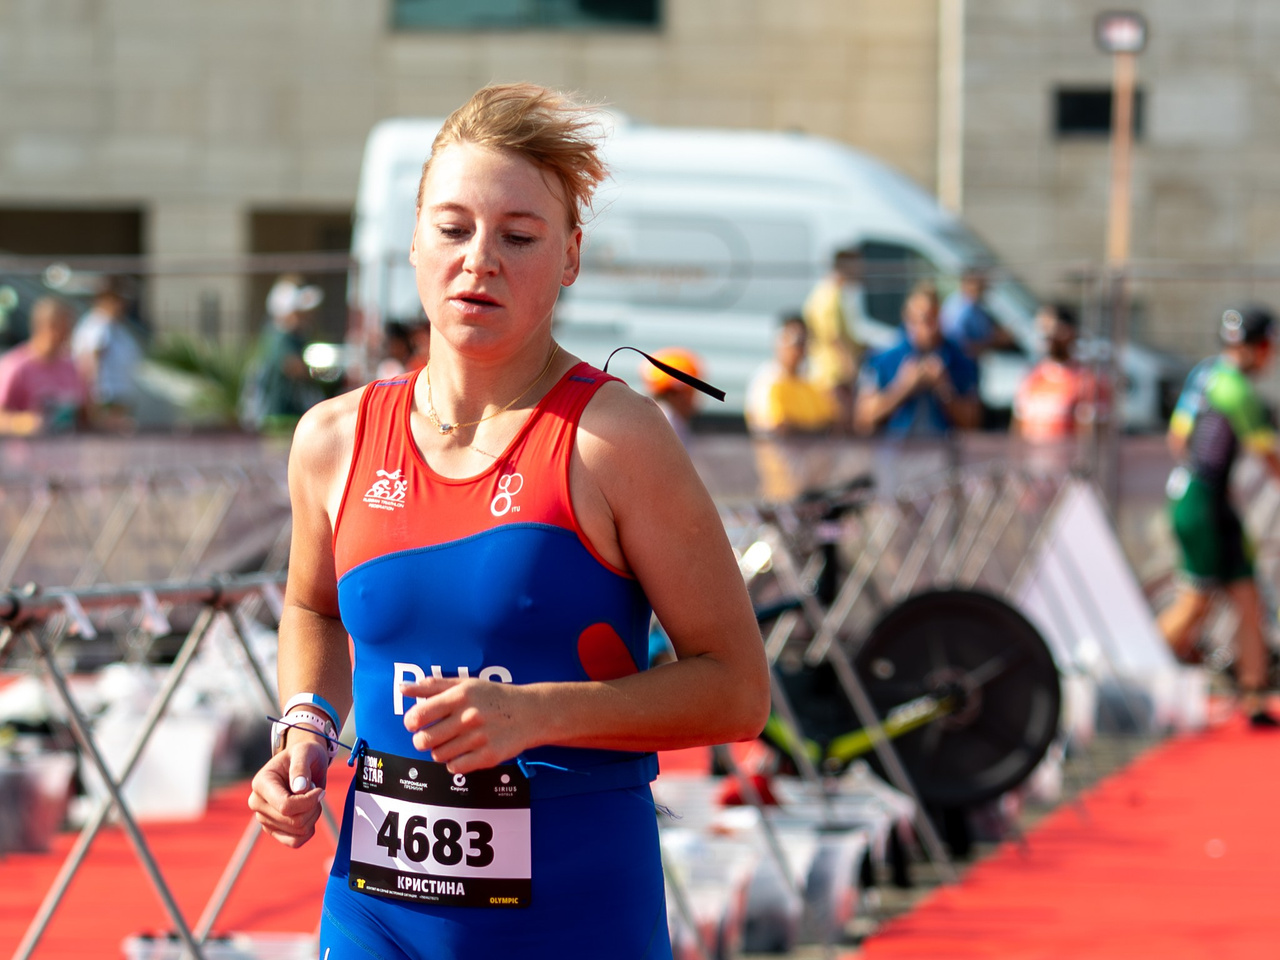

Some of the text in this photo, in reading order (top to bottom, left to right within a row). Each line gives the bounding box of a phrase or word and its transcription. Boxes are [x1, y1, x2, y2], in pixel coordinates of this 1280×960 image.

[362, 766, 384, 784] STAR
[376, 810, 495, 868] 4683
[397, 875, 466, 896] КРИСТИНА
[489, 897, 519, 905] OLYMPIC
